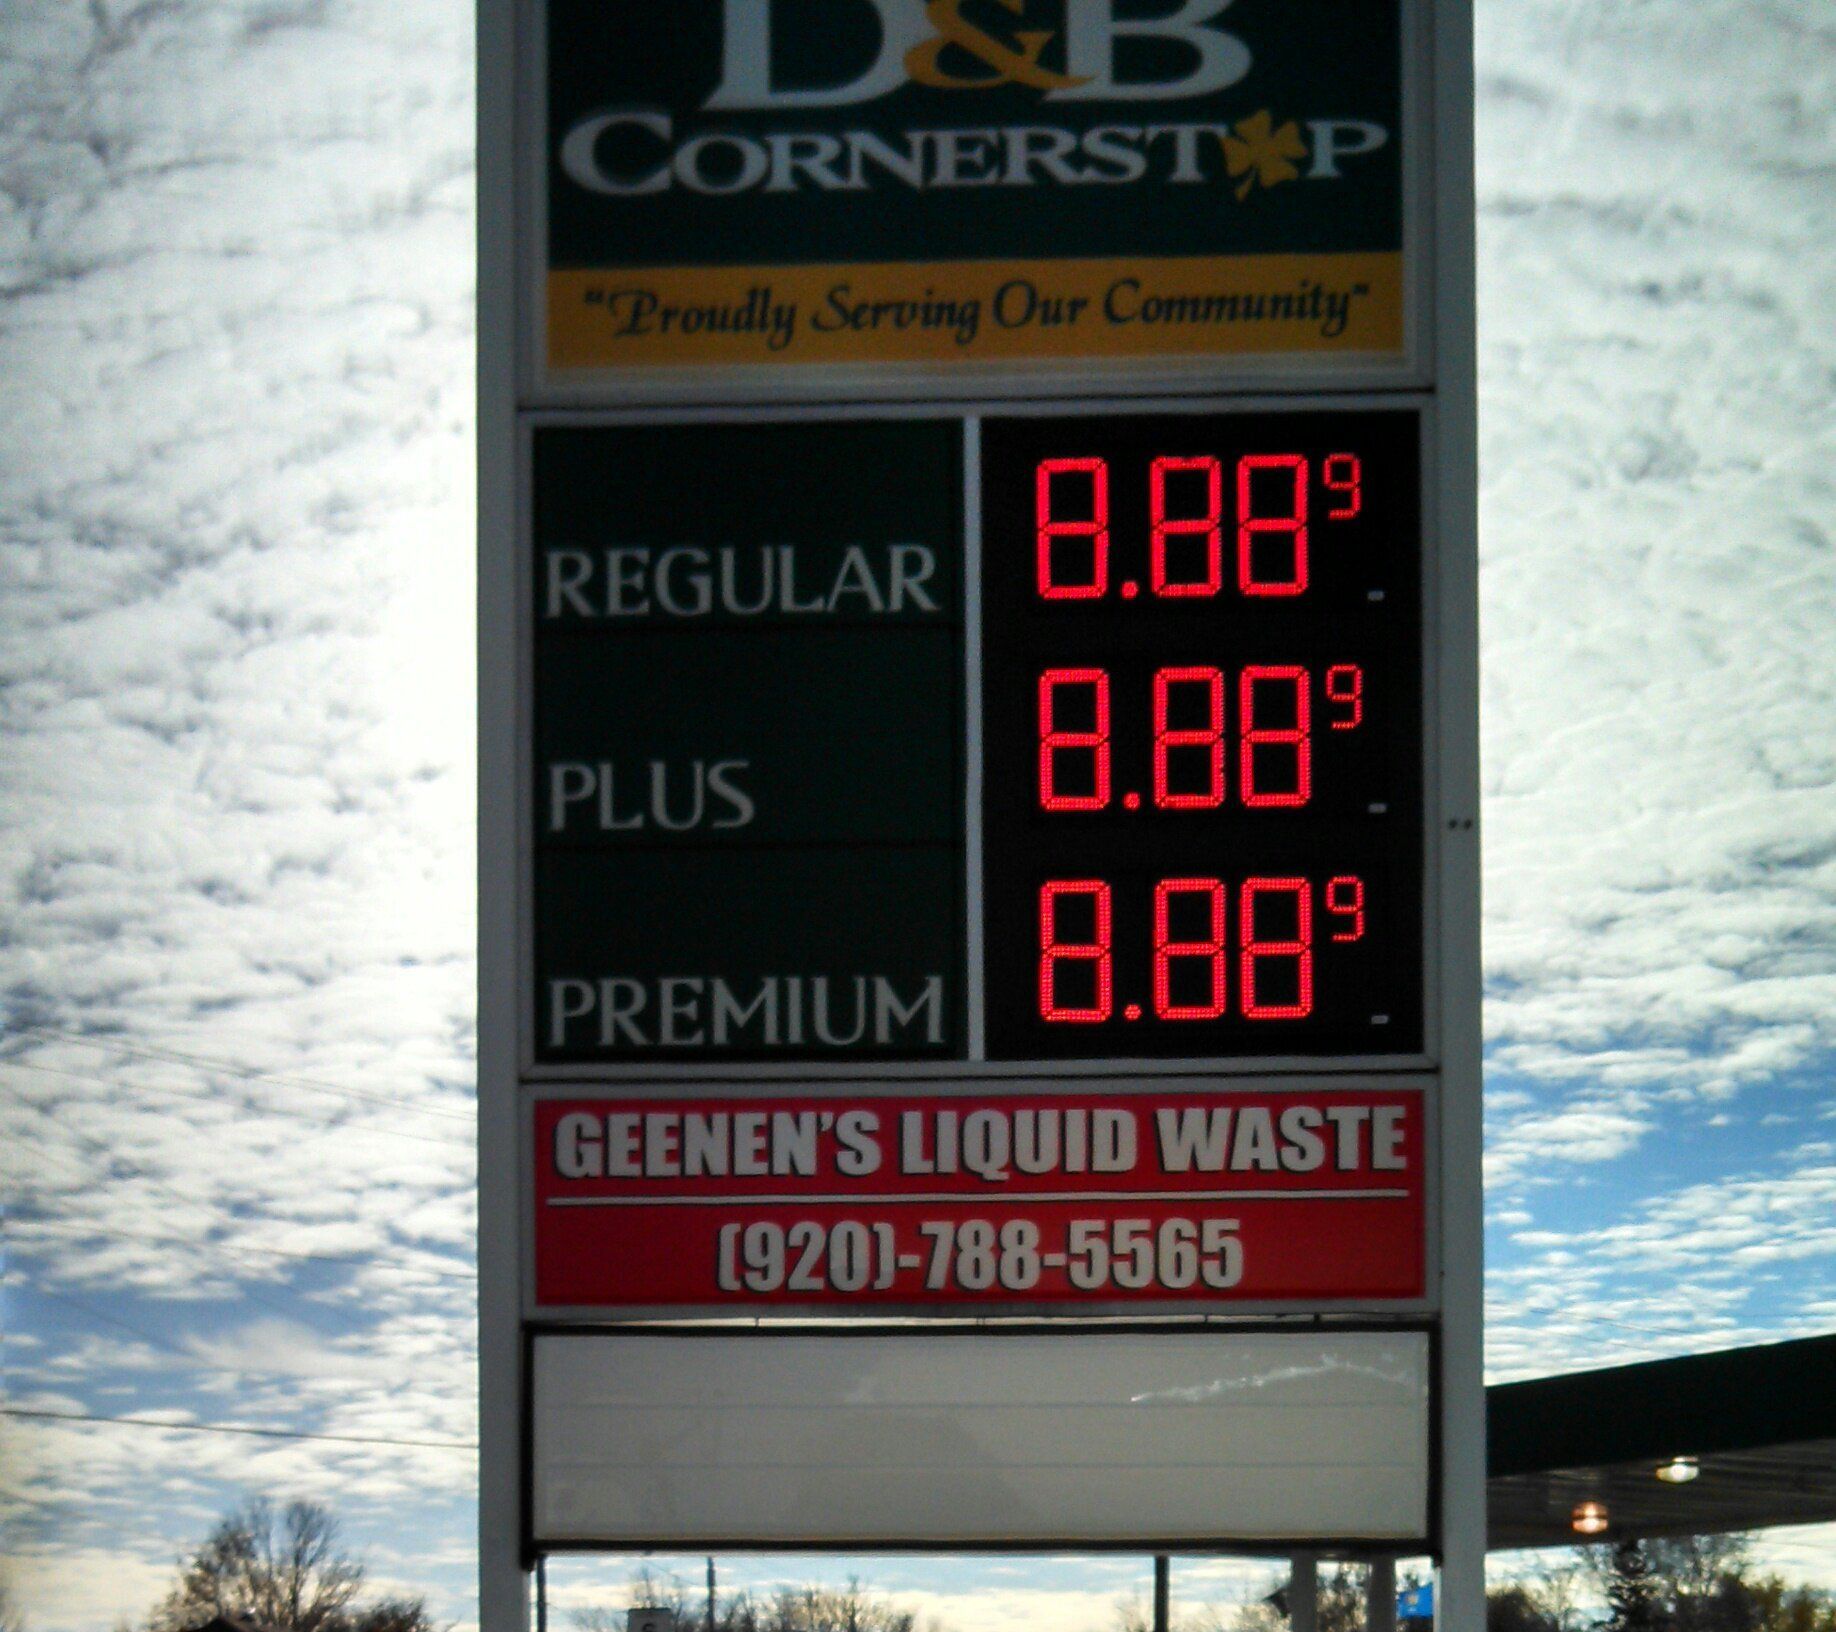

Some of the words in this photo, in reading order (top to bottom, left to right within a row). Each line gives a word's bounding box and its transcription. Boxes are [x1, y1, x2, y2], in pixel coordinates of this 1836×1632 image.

[560, 112, 1391, 195] CORNERSTP
[811, 281, 980, 343] Serving
[992, 280, 1089, 330] Our
[545, 545, 939, 619] REGULAR
[548, 760, 755, 831] PLUS
[548, 975, 945, 1046] PREMIUM
[555, 1110, 881, 1180] GEENEN'S
[901, 1108, 1138, 1181] LIQUID
[1157, 1105, 1408, 1173] WASTE
[716, 1217, 1244, 1292] (920)-788-5565
